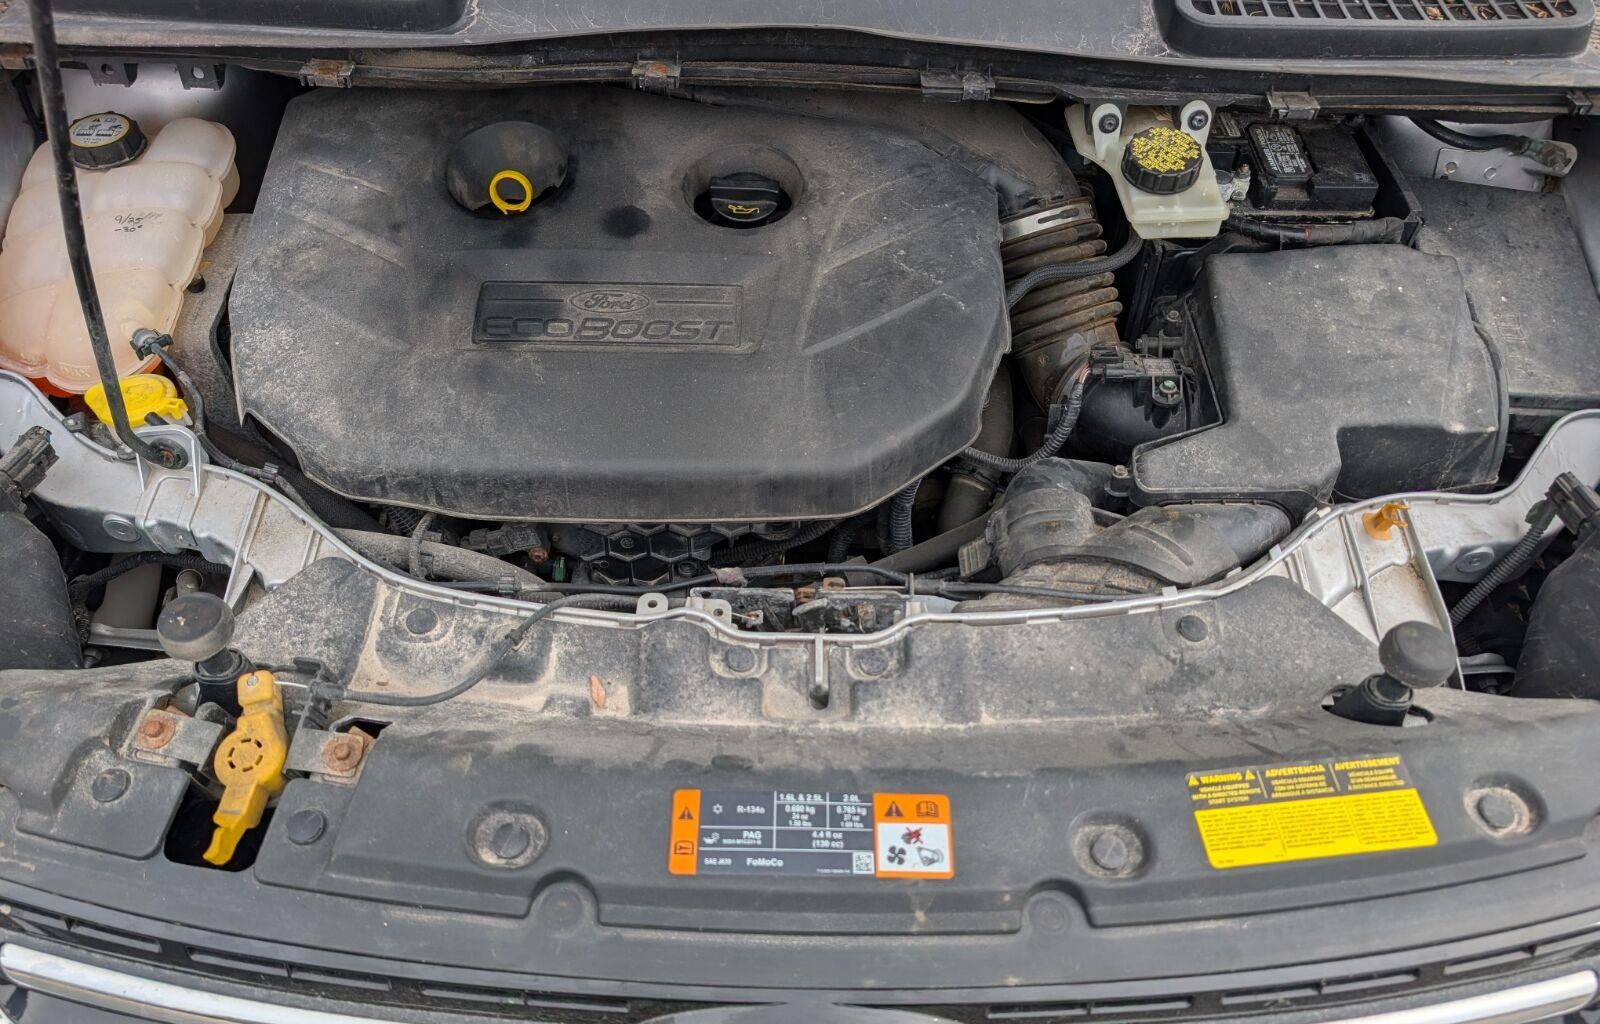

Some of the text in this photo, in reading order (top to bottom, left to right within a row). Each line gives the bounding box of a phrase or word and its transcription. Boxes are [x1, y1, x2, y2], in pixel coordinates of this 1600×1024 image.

[583, 293, 636, 310] Ford
[1335, 756, 1400, 771] AVERTISSEMENT
[1265, 764, 1326, 778] ADVERTENCIA
[1200, 772, 1243, 785] WARNING
[736, 805, 766, 814] R-134a
[805, 805, 816, 815] kg
[856, 806, 867, 816] kg
[743, 830, 762, 839] PAG
[812, 830, 825, 838] 4.4
[831, 840, 844, 849] cc)
[746, 857, 784, 867] FoMoCo
